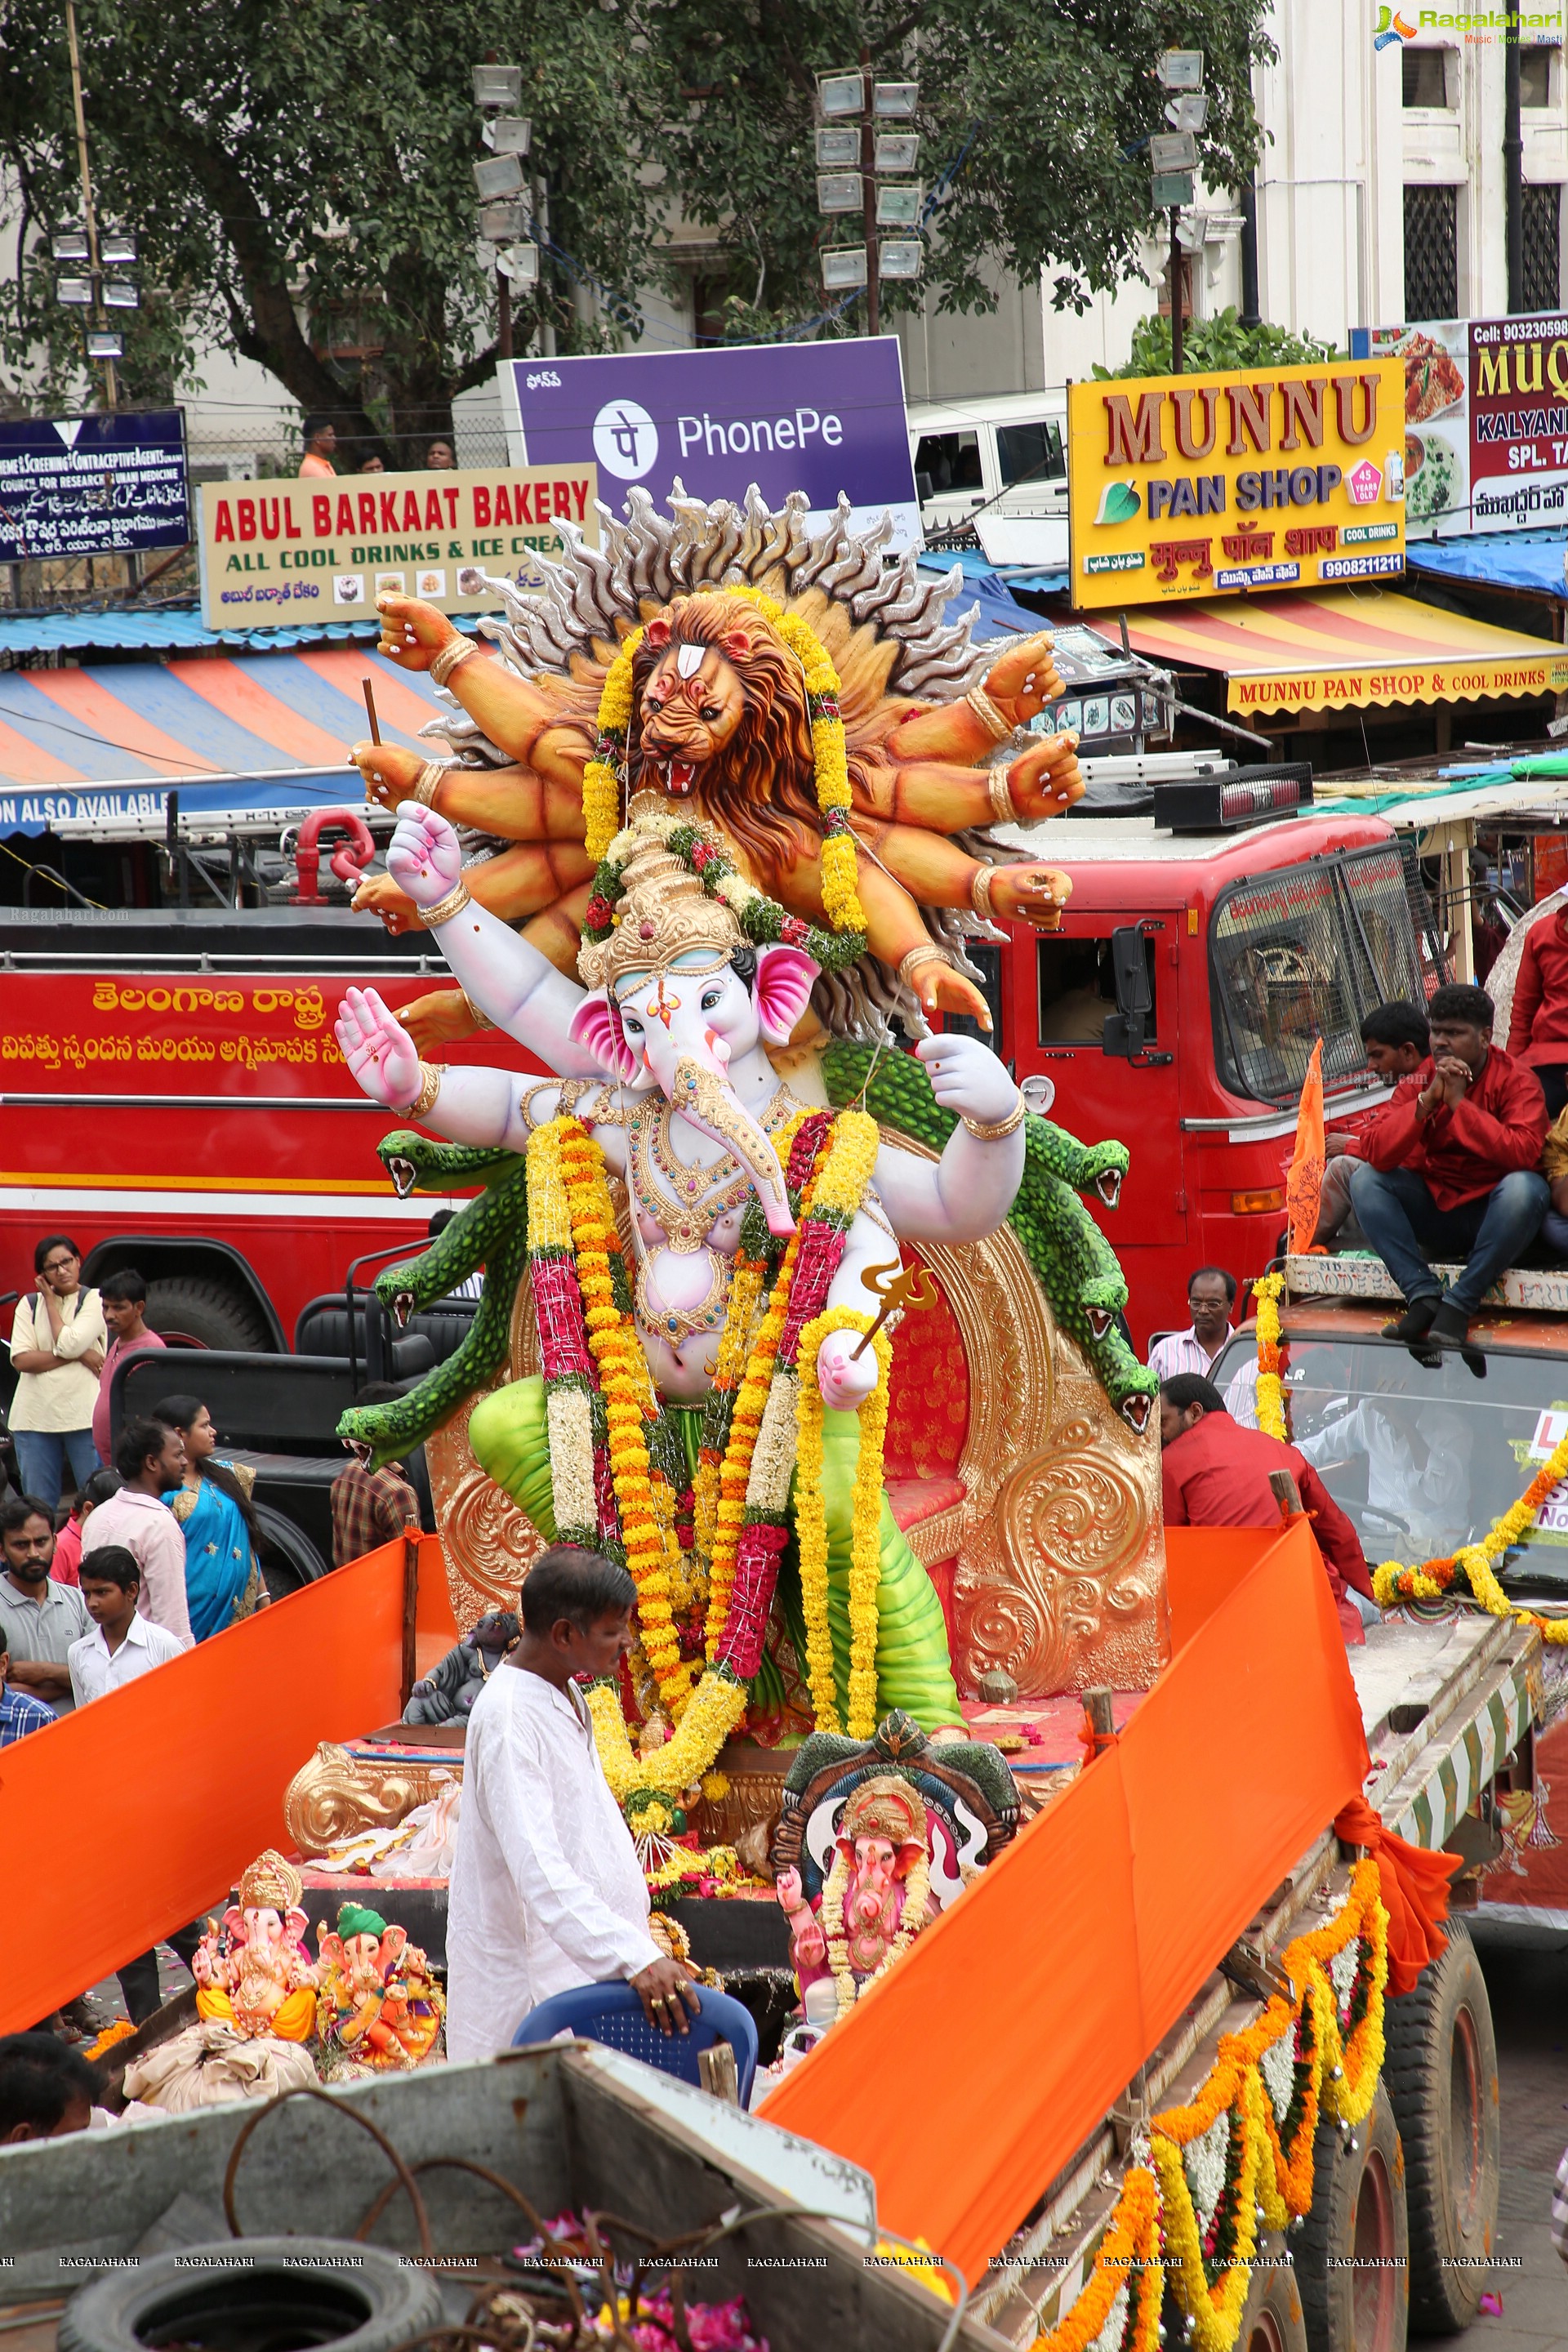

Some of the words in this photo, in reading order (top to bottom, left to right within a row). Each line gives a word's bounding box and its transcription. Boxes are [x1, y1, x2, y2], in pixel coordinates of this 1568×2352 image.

[1474, 327, 1501, 343] Cell:
[677, 408, 844, 458] PhonePe
[1102, 374, 1383, 466] MUNNU
[1508, 444, 1548, 470] SPL.
[39, 476, 58, 490] FOR
[140, 467, 179, 482] MEDICINE
[1147, 474, 1226, 519] PAN
[1235, 463, 1343, 511] SHOP
[1356, 483, 1378, 492] YEARS
[1359, 469, 1371, 481] 45
[215, 497, 301, 542] ABUL
[314, 488, 460, 537] BARKAAT
[473, 479, 590, 528] BAKERY
[1360, 492, 1374, 501] OLD
[1284, 525, 1339, 557] शाप
[1346, 528, 1367, 542] COOL
[1368, 524, 1396, 539] DRINKS
[225, 554, 270, 572] ALL
[280, 548, 341, 569] COOL
[351, 542, 440, 564] DRINKS
[448, 541, 463, 559] &
[472, 537, 504, 557] ICE
[511, 535, 583, 554] CREA
[1325, 555, 1402, 578] 9908211211
[1239, 679, 1316, 704] MUNNU
[1323, 677, 1363, 699] PAN
[1369, 675, 1426, 697] SHOP
[1432, 673, 1446, 692] &
[1452, 675, 1490, 692] COOL
[1493, 670, 1545, 688] DRINKS
[21, 797, 71, 822] ALSO
[76, 792, 169, 818] AVAILABLE
[91, 982, 244, 1012] తెలంగాణ
[252, 984, 327, 1031] రాష్ట్ర
[1, 1034, 61, 1070] విపత్తు
[63, 1034, 132, 1070] స్పందన
[136, 1036, 216, 1062] మరియు
[220, 1035, 318, 1071] అగ్నిమాపక
[1537, 1416, 1558, 1448] L
